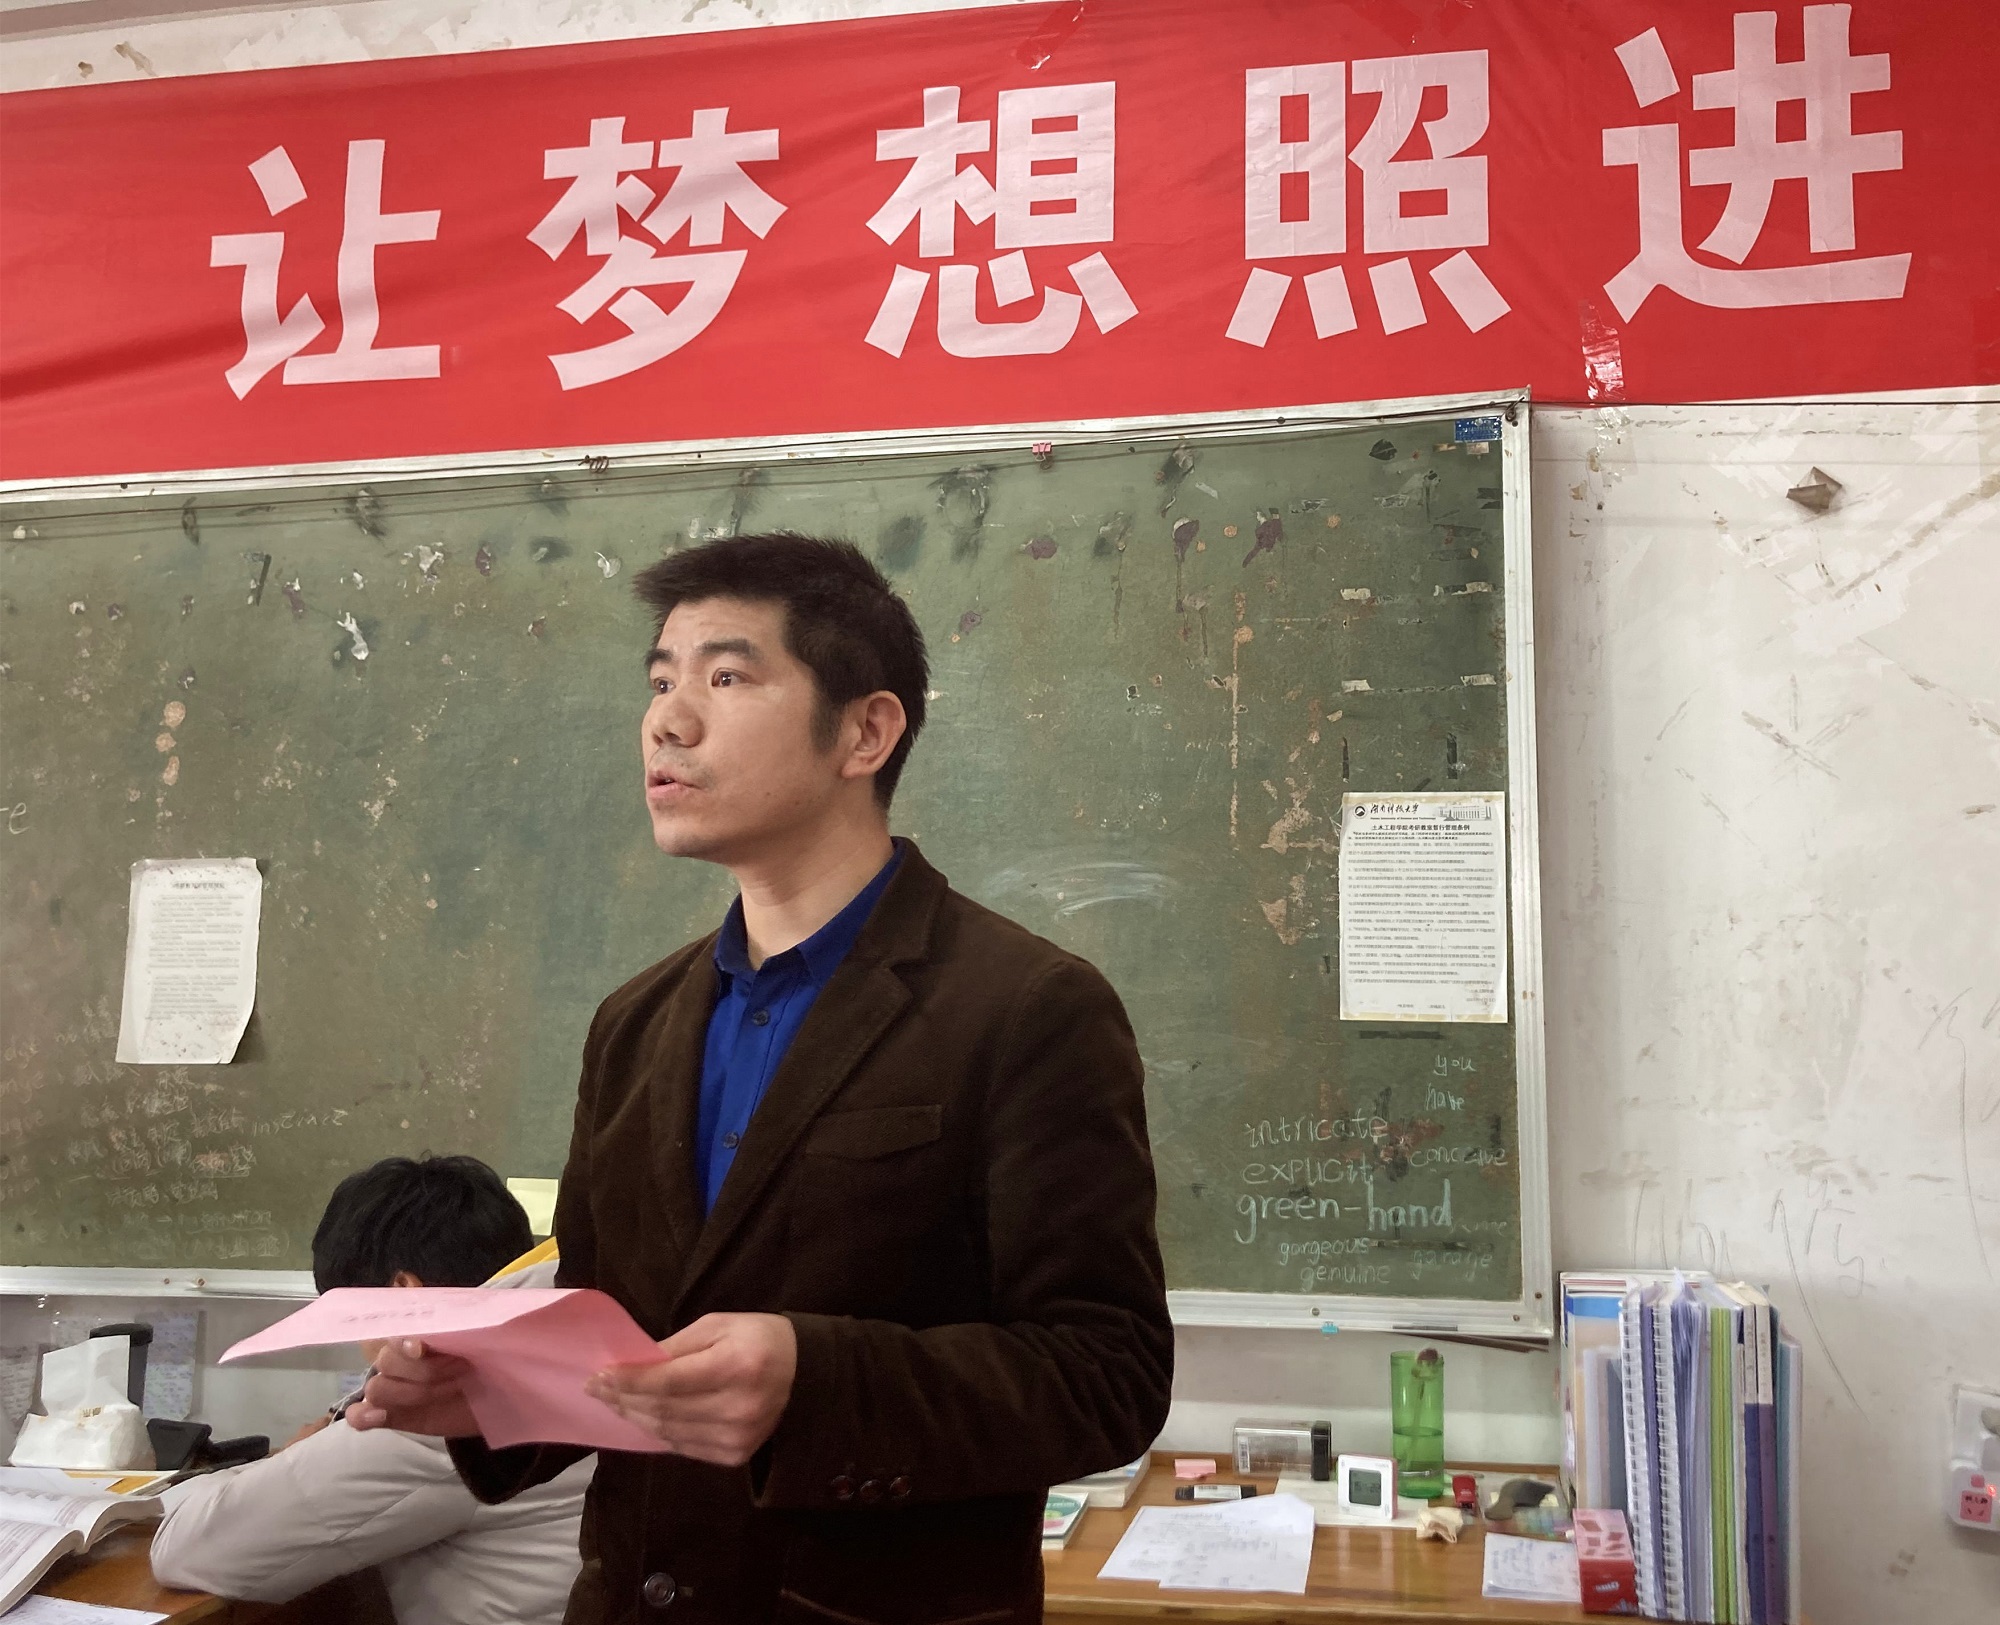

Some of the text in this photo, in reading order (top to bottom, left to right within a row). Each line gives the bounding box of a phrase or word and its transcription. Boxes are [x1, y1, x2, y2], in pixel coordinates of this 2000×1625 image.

[209, 3, 1912, 400] 让梦想照进
[1433, 1054, 1477, 1077] you
[1244, 1108, 1389, 1148] intricate
[1234, 1178, 1452, 1244] green-hand
[1278, 1237, 1370, 1266] gorgeous
[1300, 1264, 1391, 1293] genuine
